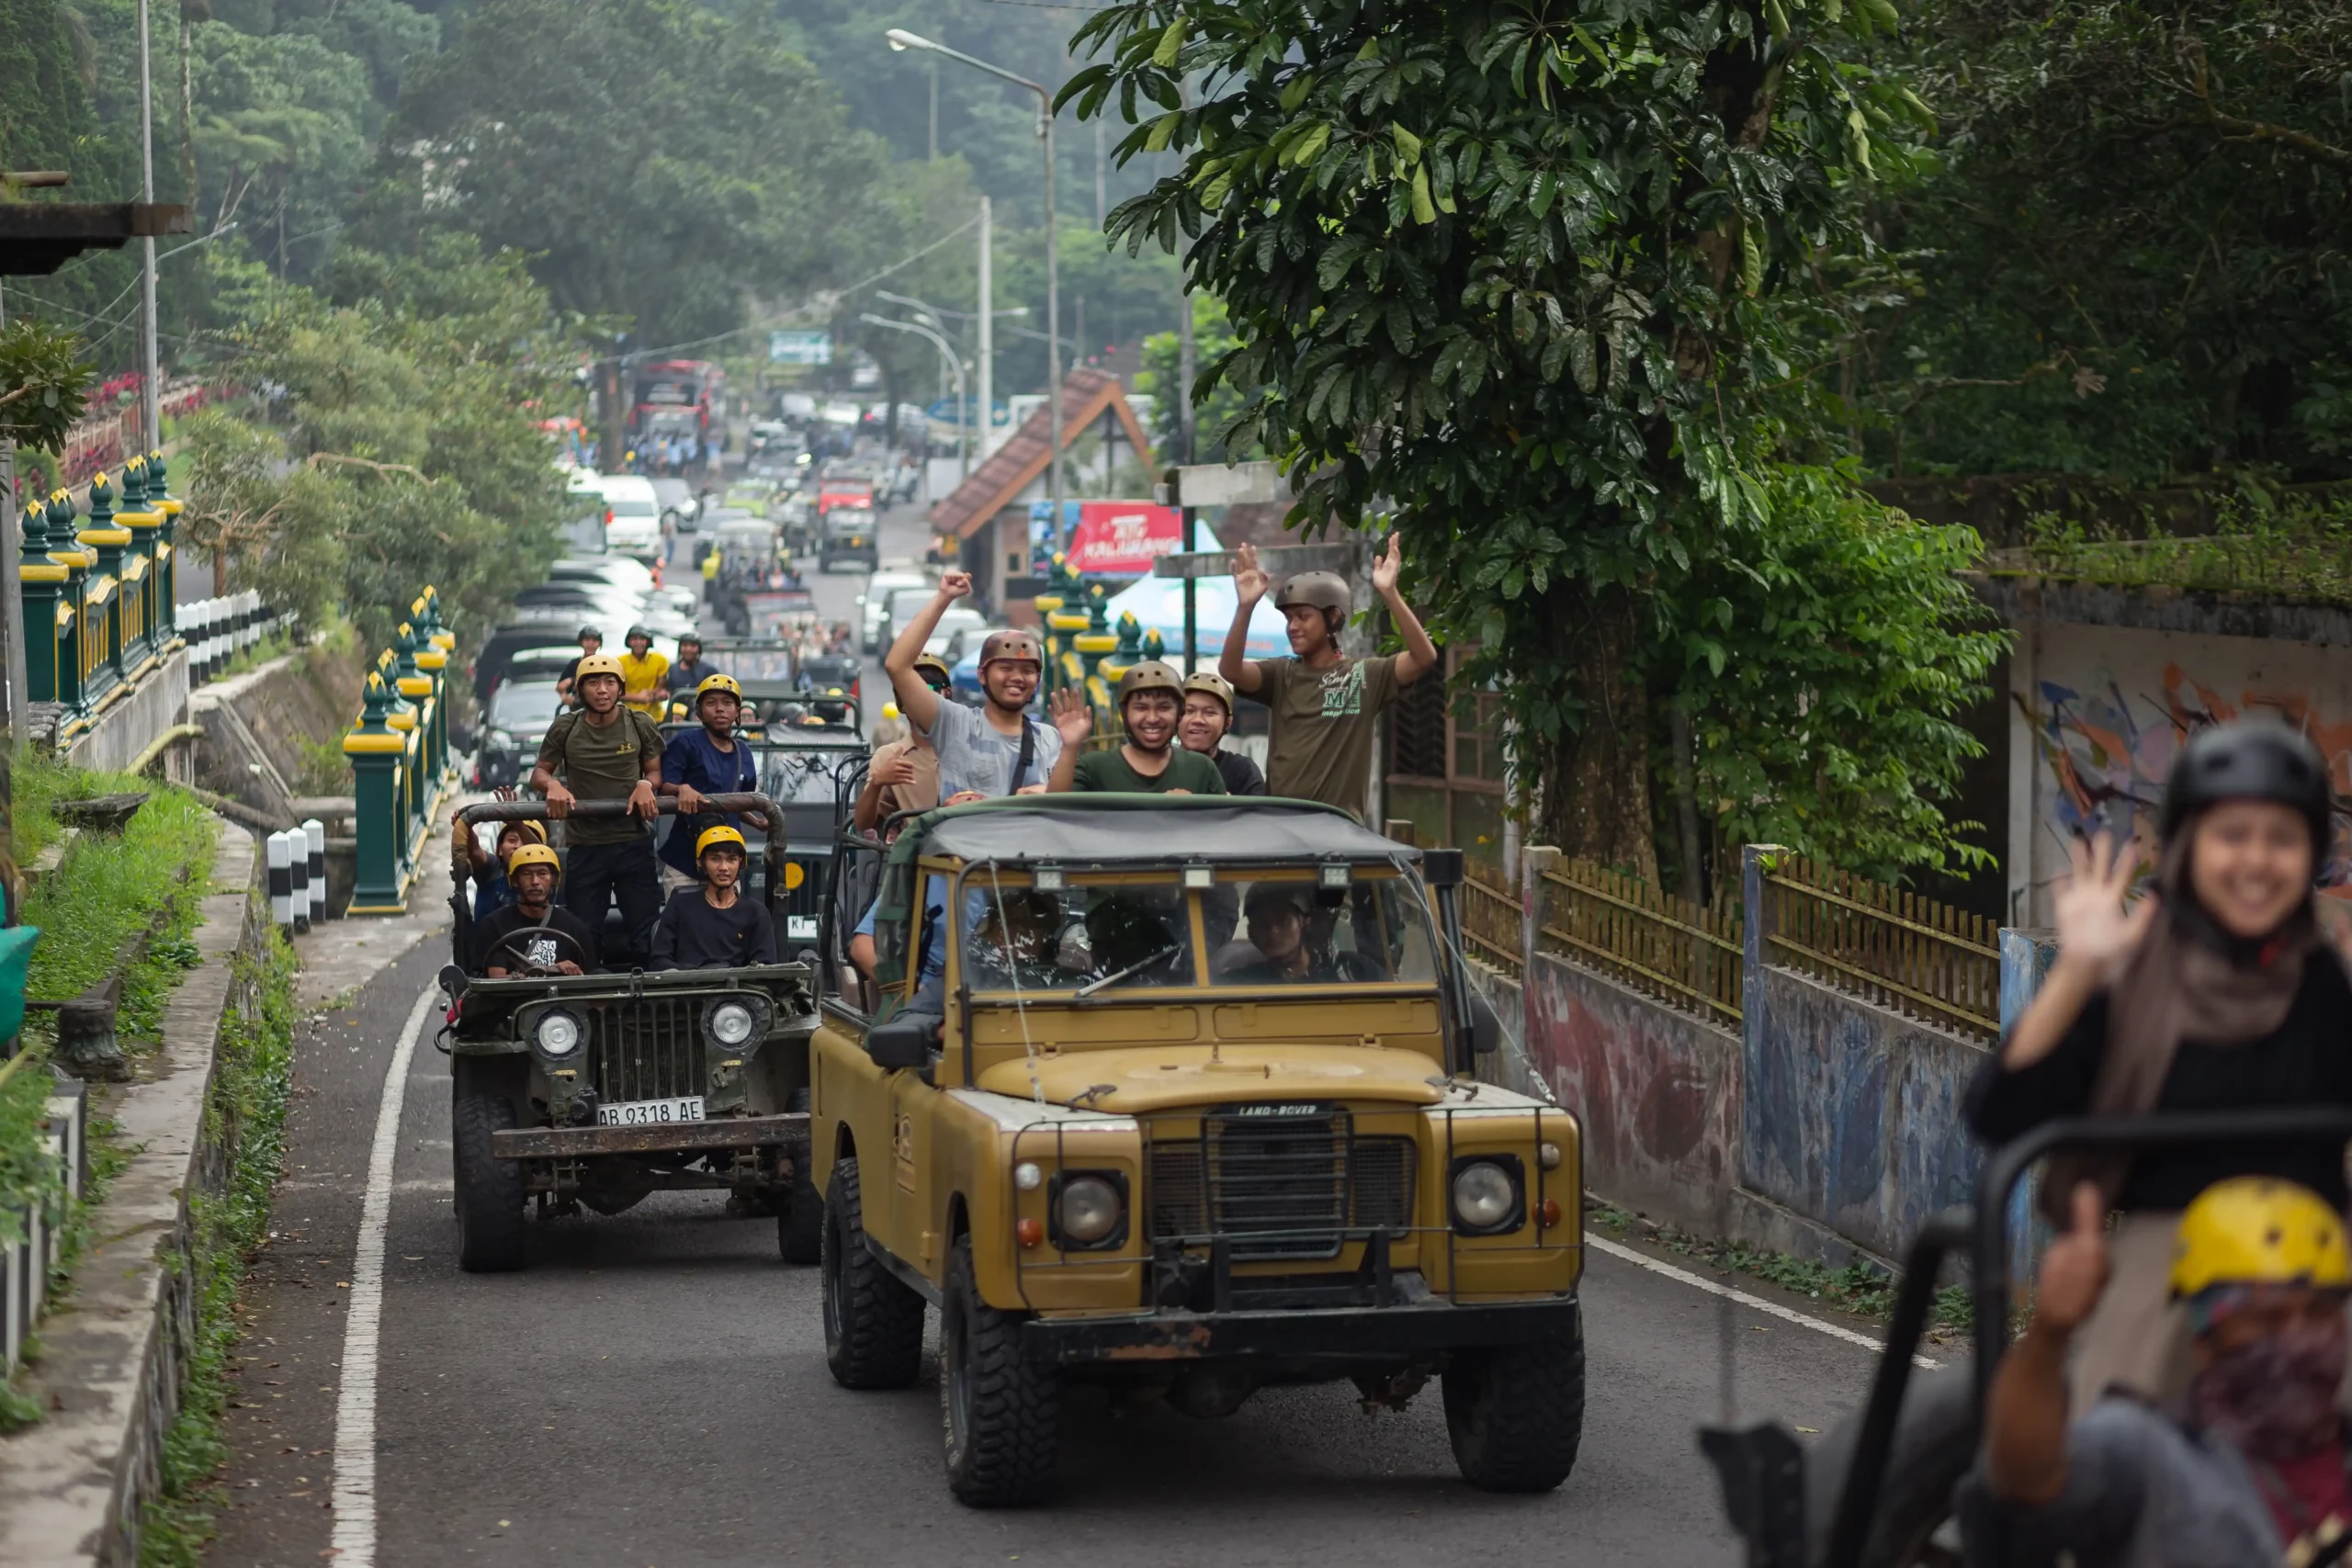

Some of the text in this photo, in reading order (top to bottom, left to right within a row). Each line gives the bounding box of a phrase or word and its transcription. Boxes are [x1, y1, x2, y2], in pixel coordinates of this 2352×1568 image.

[599, 1100, 701, 1126] AB 9318 AE
[1239, 1105, 1317, 1117] LAND-ROVER
